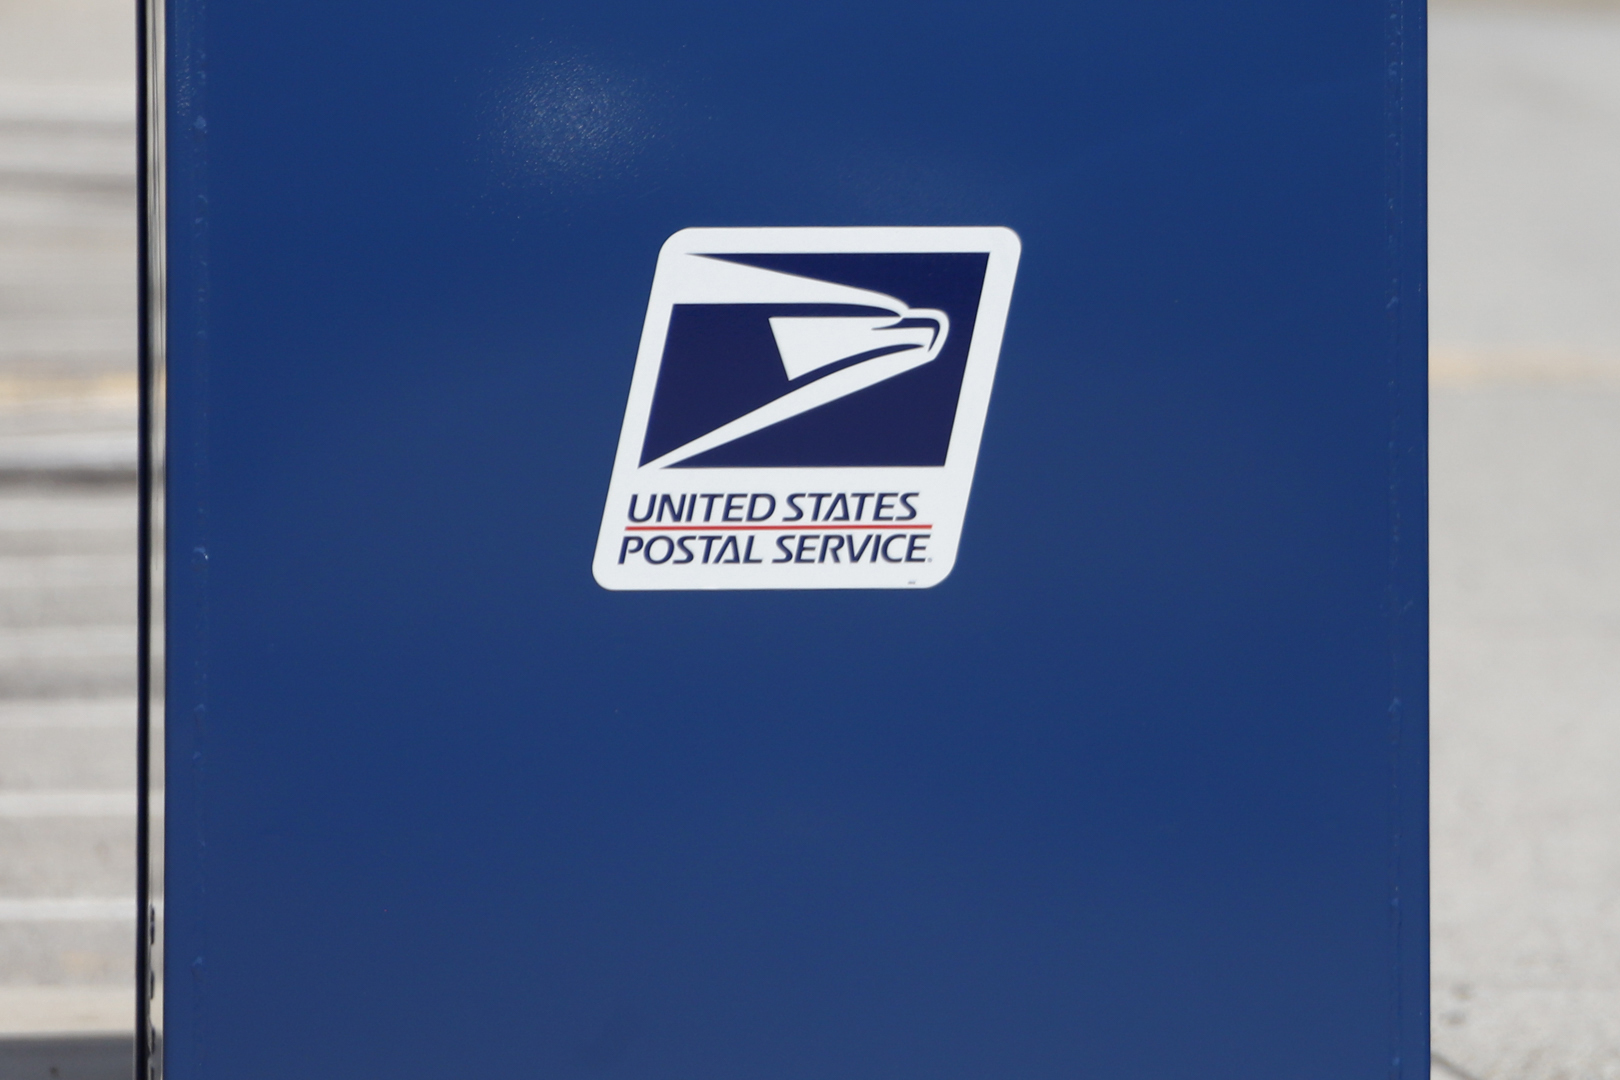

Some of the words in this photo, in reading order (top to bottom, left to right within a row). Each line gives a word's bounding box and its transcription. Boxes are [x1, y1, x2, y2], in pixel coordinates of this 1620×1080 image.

[627, 492, 777, 523] UNITED
[781, 491, 920, 522] STATES
[617, 534, 763, 565] POSTAL
[771, 533, 932, 565] SERVICE
